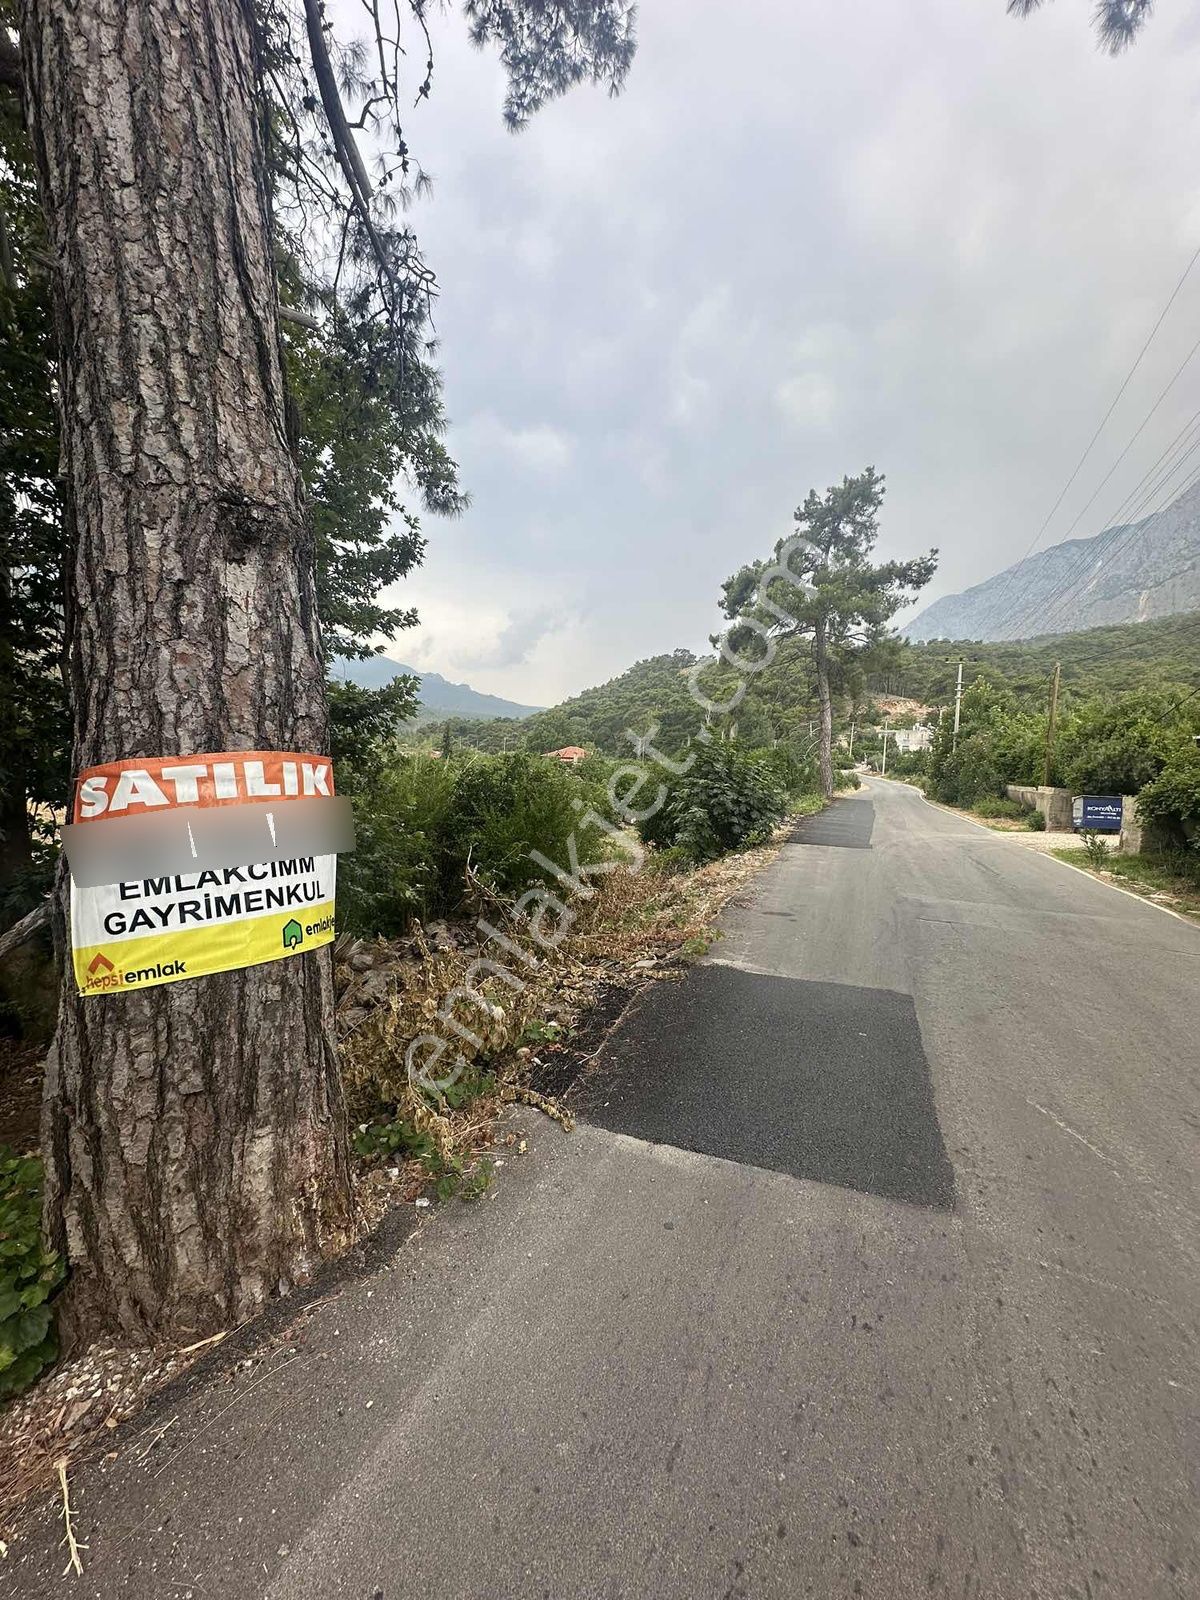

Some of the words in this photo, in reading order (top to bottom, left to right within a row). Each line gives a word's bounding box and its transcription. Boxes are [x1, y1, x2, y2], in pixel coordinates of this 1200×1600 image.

[80, 761, 331, 818] SATILIK
[104, 880, 325, 935] GAYRİMENKUL
[86, 960, 187, 991] hepsiemlak
